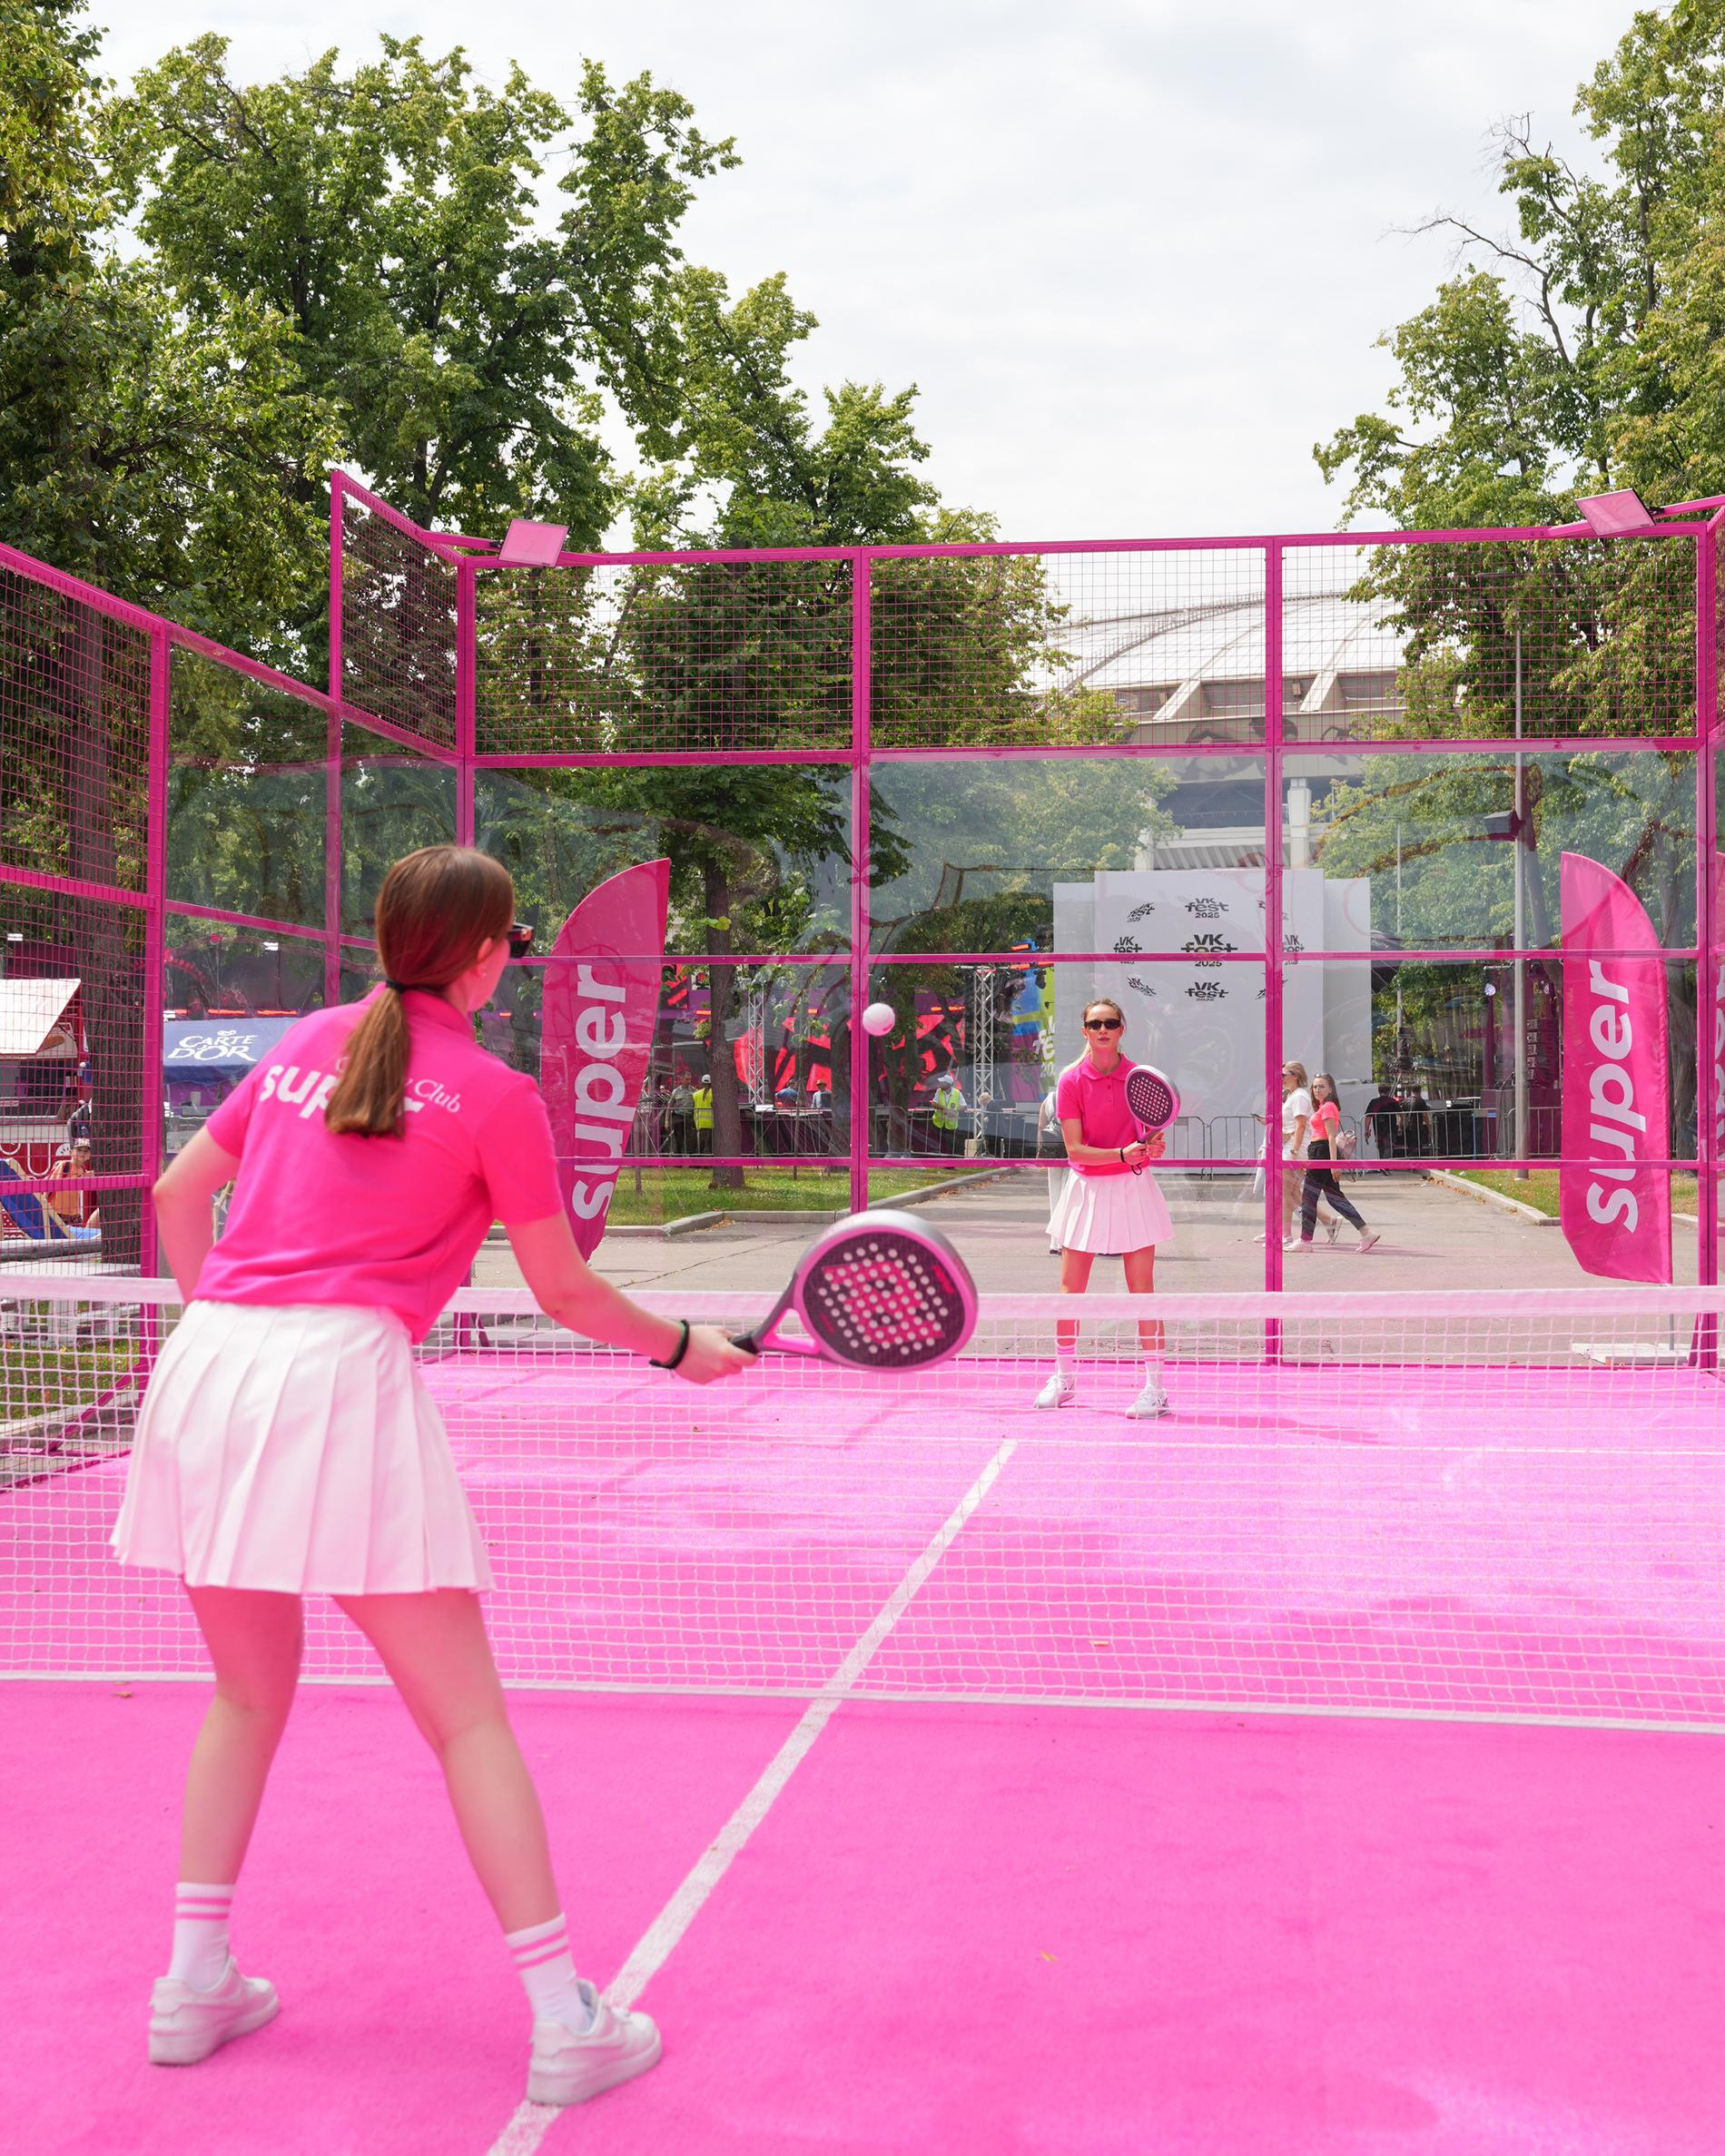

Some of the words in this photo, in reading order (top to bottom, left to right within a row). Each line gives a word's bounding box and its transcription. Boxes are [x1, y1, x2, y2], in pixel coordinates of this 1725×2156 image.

[1185, 901, 1229, 912] fest
[1119, 936, 1135, 946] VK
[1193, 934, 1224, 946] VK
[1285, 935, 1300, 945] VK
[1194, 981, 1220, 991] VK
[1184, 988, 1229, 999] fest
[179, 1035, 259, 1048] CARTE
[167, 1045, 259, 1062] D'OR
[414, 1078, 461, 1114] Club
[572, 964, 636, 1220] super
[1586, 959, 1646, 1234] super
